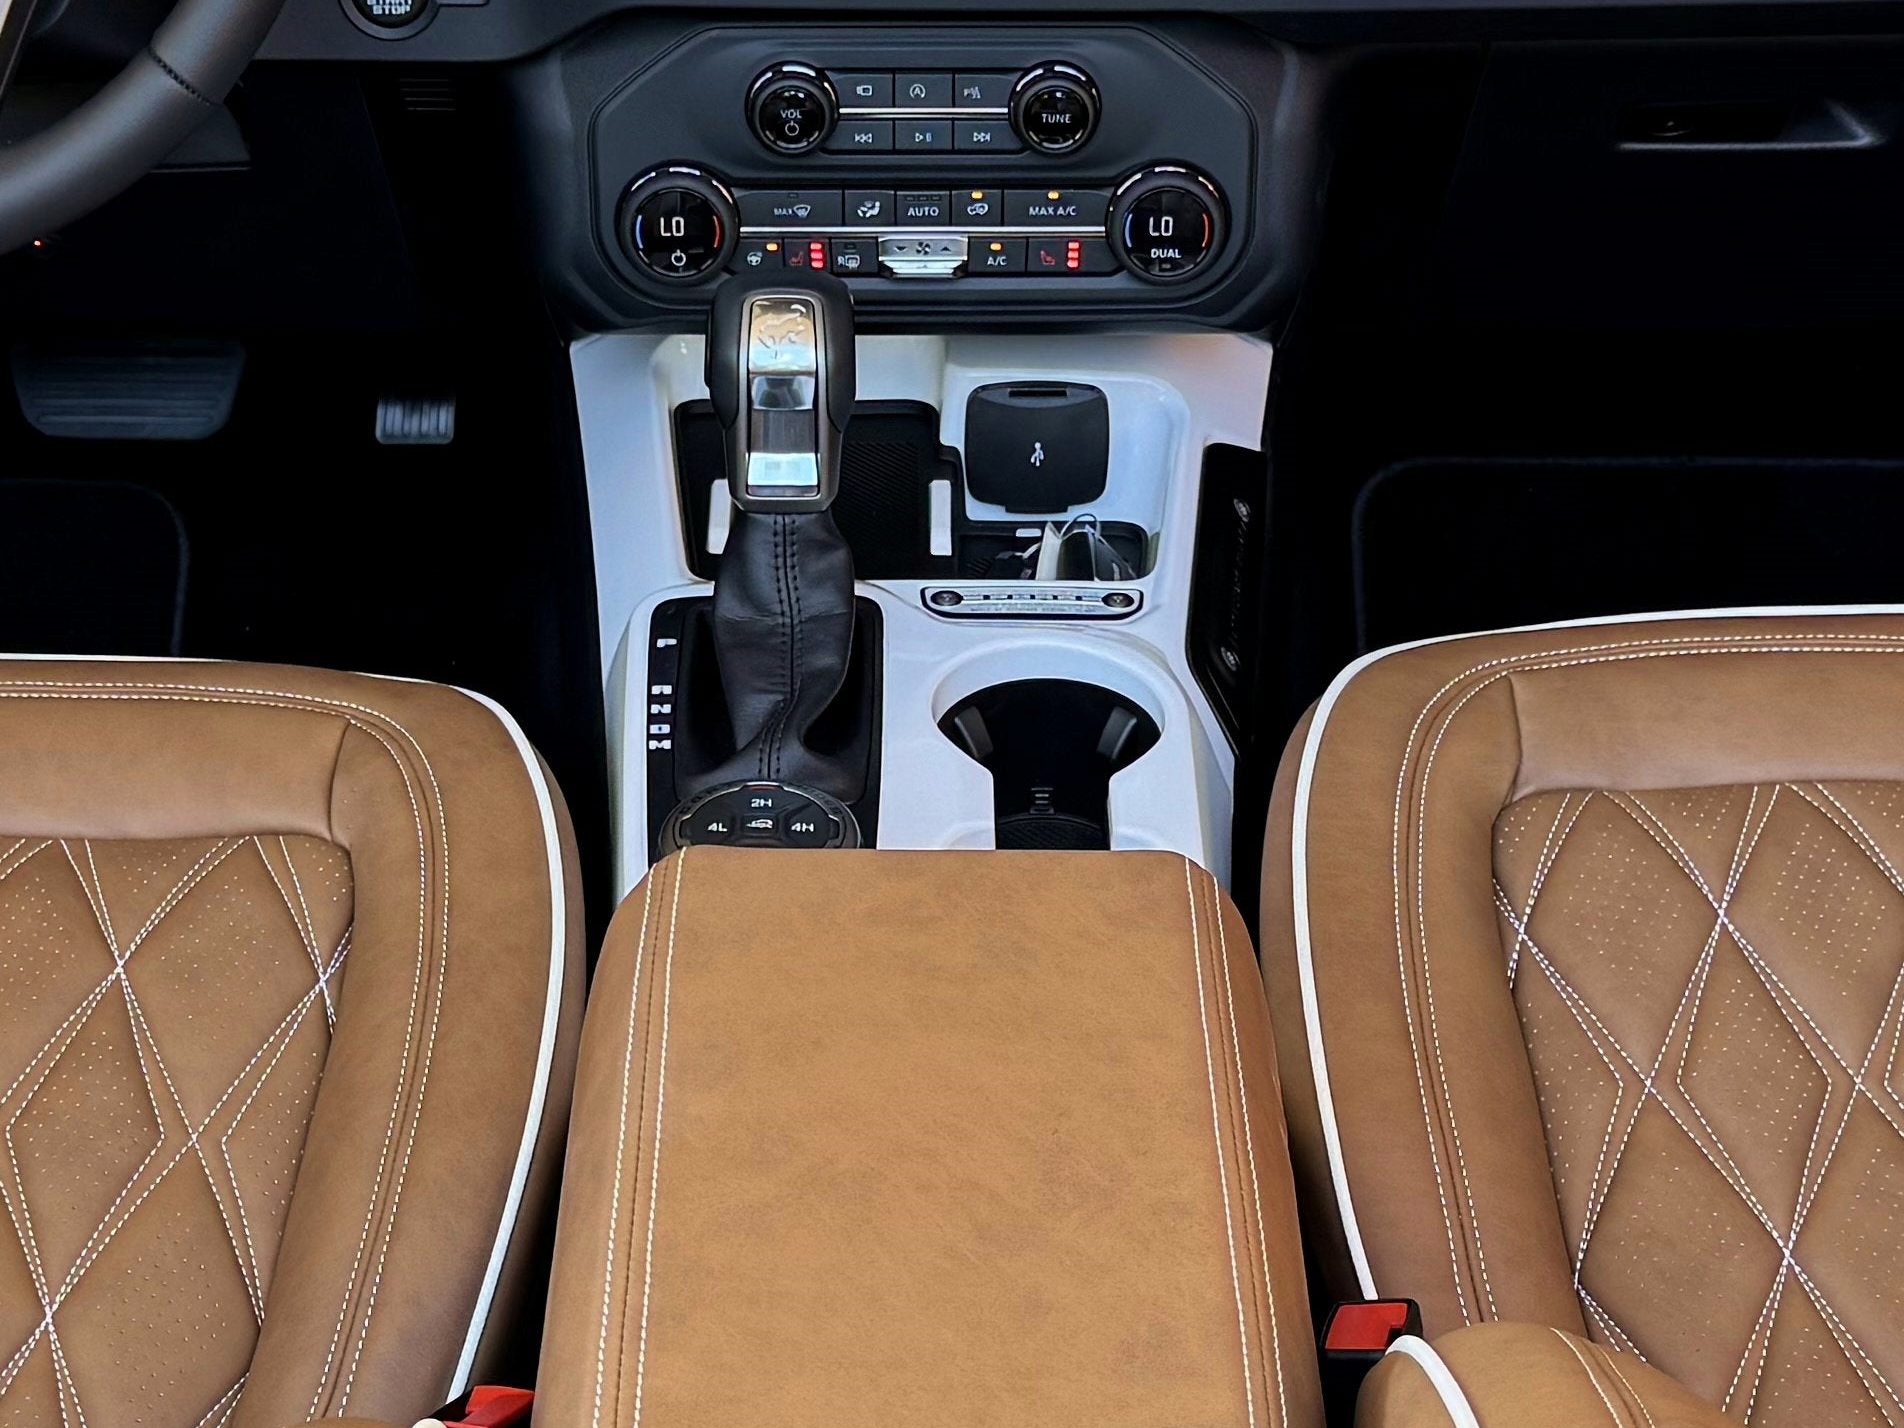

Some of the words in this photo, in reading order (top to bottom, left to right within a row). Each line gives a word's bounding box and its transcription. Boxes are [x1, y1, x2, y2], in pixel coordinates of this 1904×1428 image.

[372, 4, 411, 15] STOP
[780, 110, 802, 119] VOL
[1041, 113, 1072, 124] TUNE
[773, 207, 793, 216] MAX
[908, 207, 939, 217] AUTO
[1029, 206, 1054, 216] MAX
[1057, 205, 1077, 216] A/C
[660, 216, 685, 237] LO
[1149, 216, 1174, 237] LO
[1151, 248, 1182, 259] DUAL
[987, 256, 1007, 266] A/C
[650, 704, 672, 714] N
[649, 740, 672, 750] M
[751, 798, 772, 808] 2H
[707, 822, 728, 832] 4L
[791, 822, 814, 832] 4H
